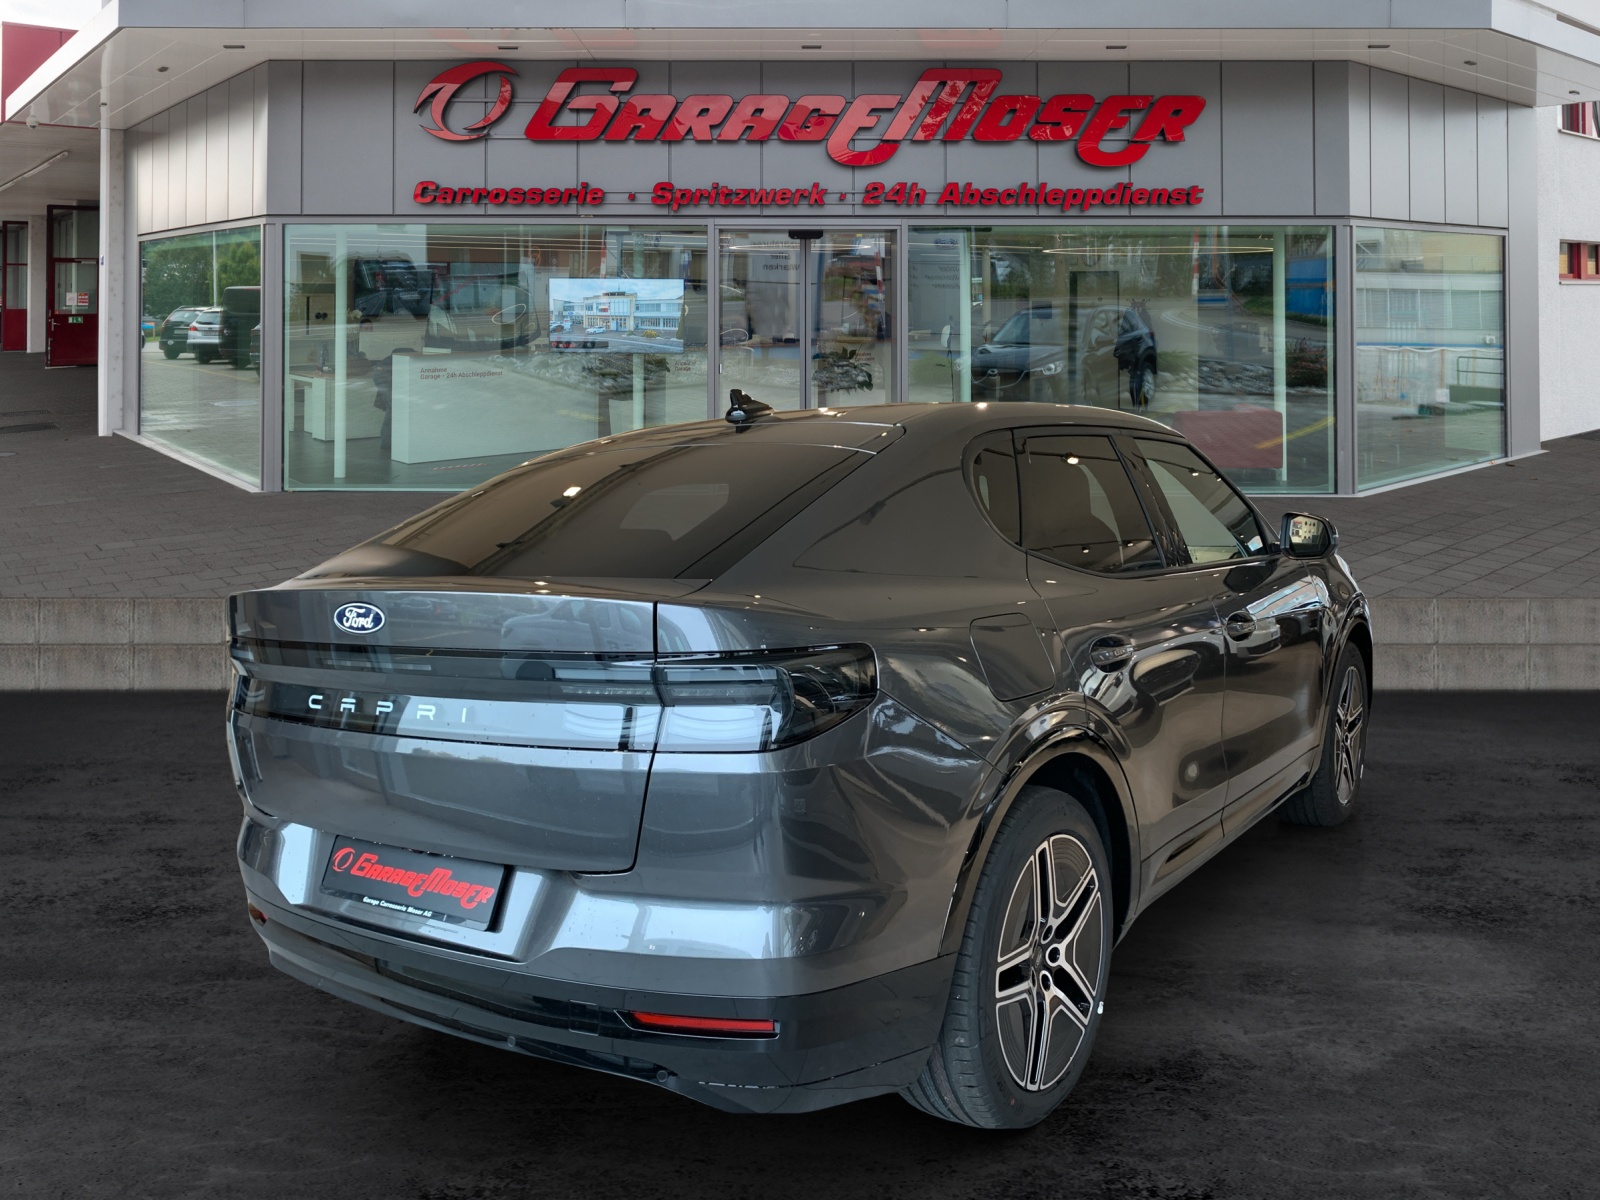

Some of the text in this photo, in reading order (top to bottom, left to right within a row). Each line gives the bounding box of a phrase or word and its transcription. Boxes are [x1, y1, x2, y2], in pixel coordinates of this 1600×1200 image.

[413, 180, 1205, 212] Carrosserie Spritzwerk 24h Abschleppdienst
[458, 370, 503, 378] Abschleppdienst
[343, 606, 374, 629] Ford
[308, 694, 467, 723] CAPRI
[362, 896, 379, 906] Garage
[407, 906, 424, 915] Moser
[423, 910, 433, 918] AG
